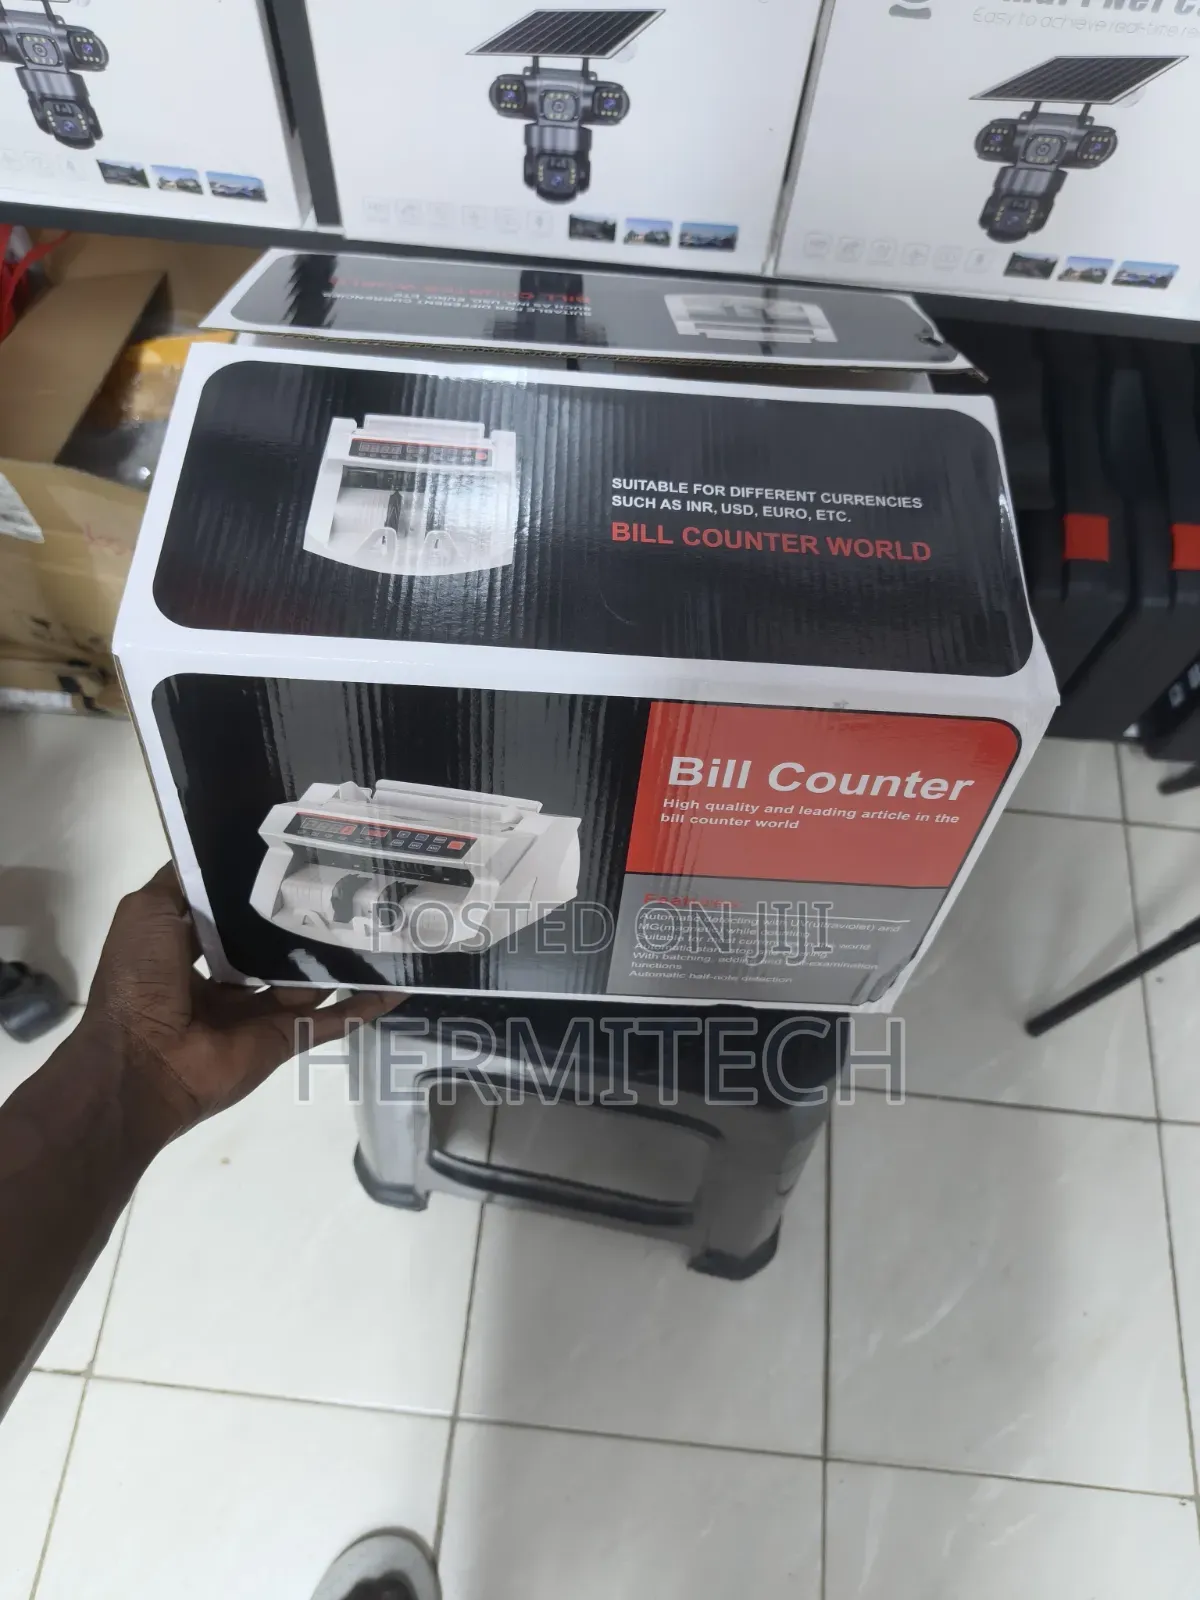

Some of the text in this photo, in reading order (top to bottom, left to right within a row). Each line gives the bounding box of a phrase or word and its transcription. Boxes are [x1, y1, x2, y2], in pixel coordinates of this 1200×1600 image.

[612, 477, 923, 509] SUITABLE FOR DIFFERENT CURRENCIES
[611, 495, 852, 523] SUCH AS INR, USD, EURO, ETC.
[611, 521, 932, 562] BILL COUNTER WORLD
[667, 756, 975, 802] Bill Counter
[663, 798, 960, 824] High quality and leading article in the
[660, 813, 800, 830] bill counter world
[728, 926, 757, 935] while
[877, 925, 901, 933] and
[838, 943, 872, 951] world
[633, 951, 659, 960] With
[631, 961, 682, 970] functions
[629, 970, 686, 979] Automatic
